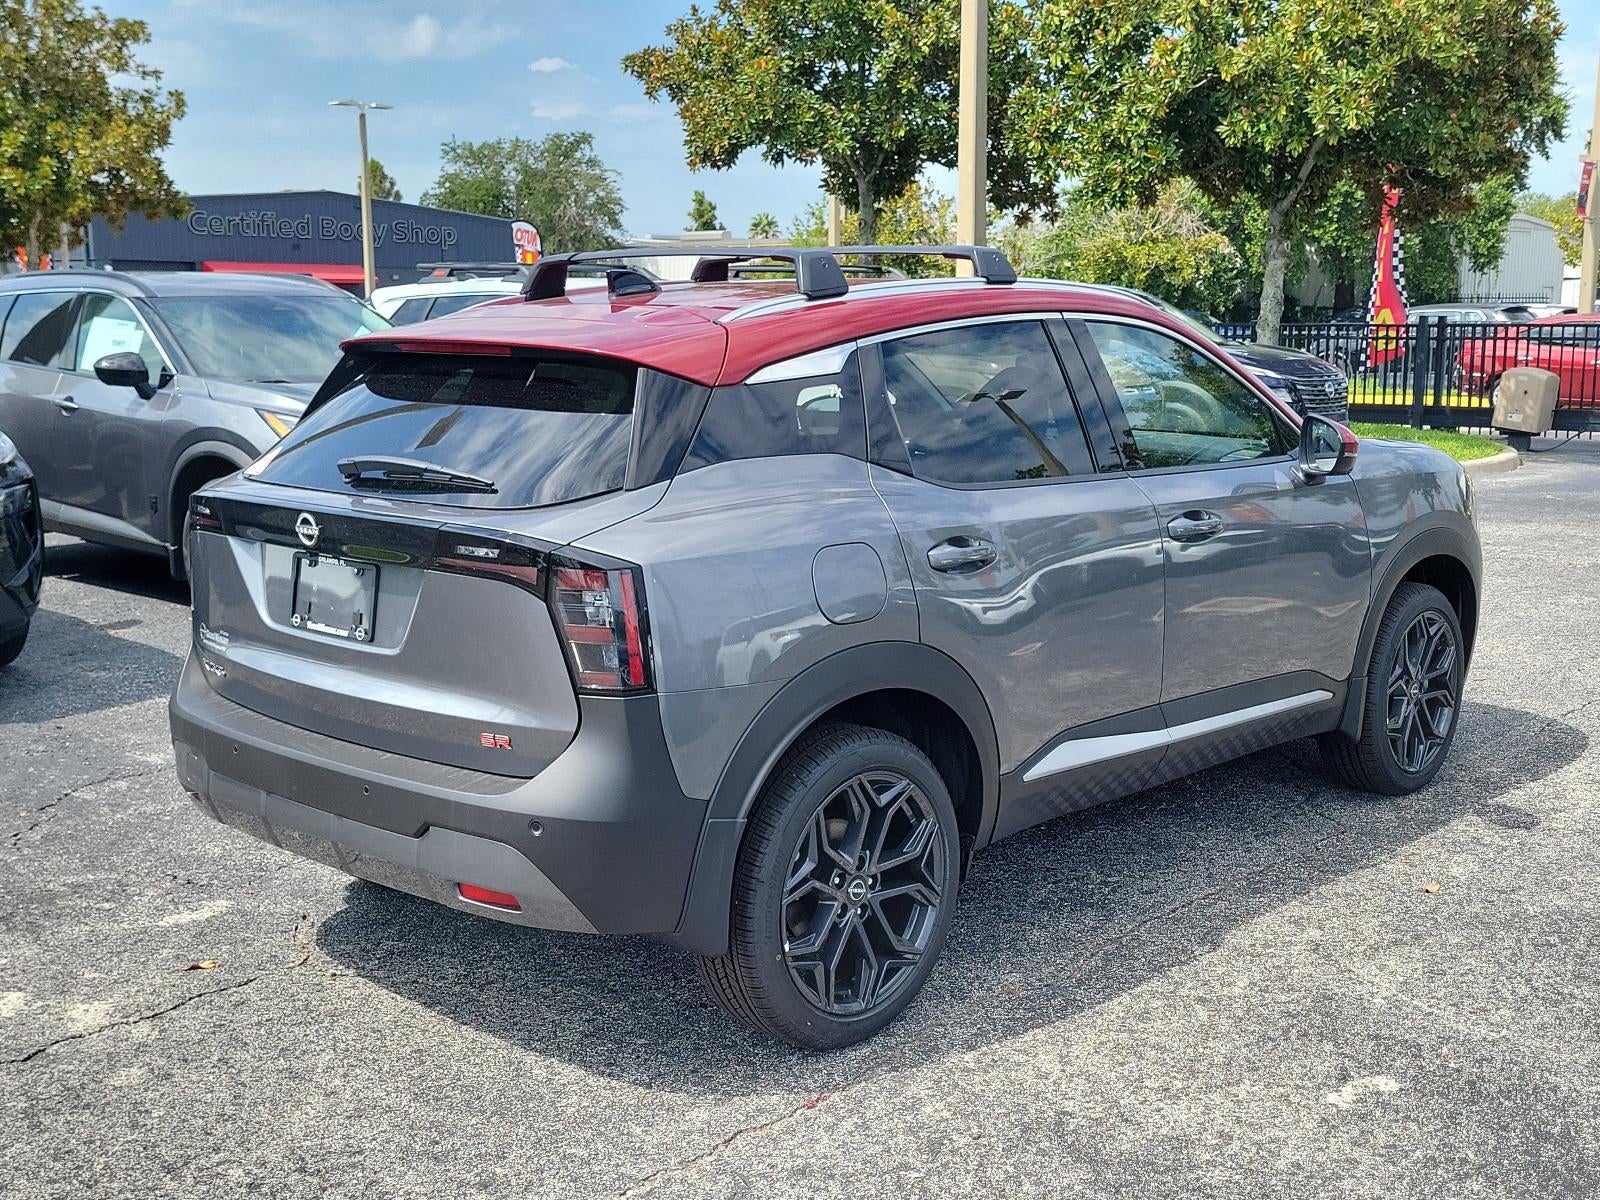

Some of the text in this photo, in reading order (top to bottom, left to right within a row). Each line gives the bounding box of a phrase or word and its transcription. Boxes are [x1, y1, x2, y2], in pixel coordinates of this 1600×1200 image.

[187, 210, 313, 239] Certified
[392, 219, 458, 250] Shop
[479, 732, 512, 750] SR
